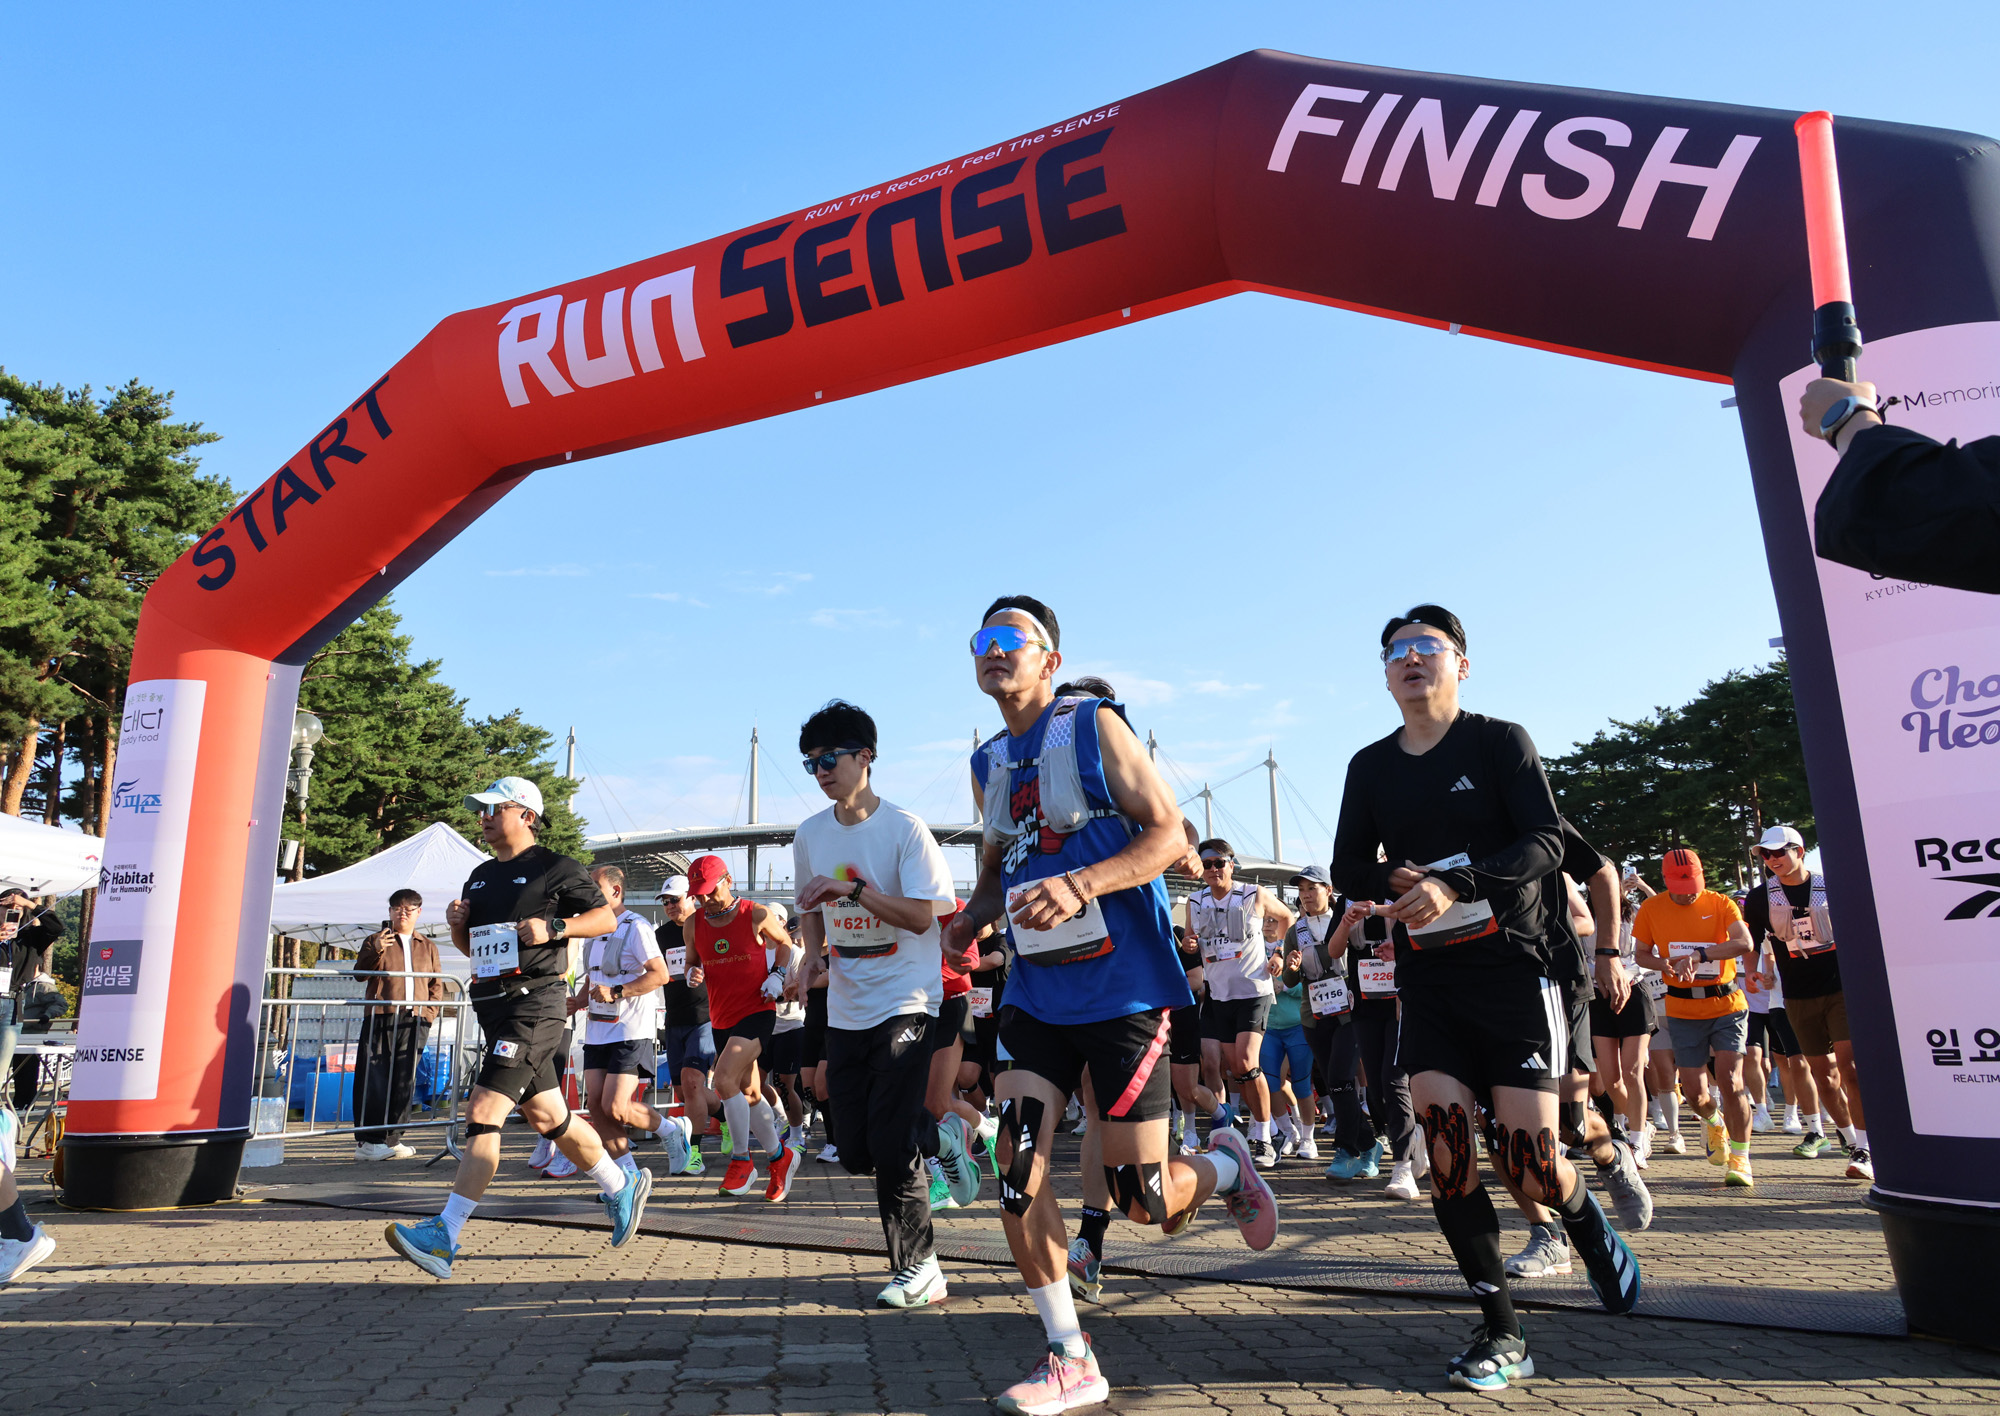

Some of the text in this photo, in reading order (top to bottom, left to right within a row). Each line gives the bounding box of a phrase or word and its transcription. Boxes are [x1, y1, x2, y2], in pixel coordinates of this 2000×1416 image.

[804, 105, 1121, 221] RUN The Record, Feel The SENSE
[1267, 83, 1762, 241] FINISH
[192, 375, 393, 591] START
[138, 733, 159, 742] food
[122, 793, 162, 814] 피죤
[111, 871, 155, 885] Habitat
[110, 885, 153, 895] for Humanity
[833, 916, 881, 930] W 6217
[477, 941, 510, 958] 1113
[85, 965, 133, 989] 동원샘물
[1363, 973, 1370, 981] W
[1318, 988, 1343, 1002] 1156
[100, 1048, 145, 1062] SENSE
